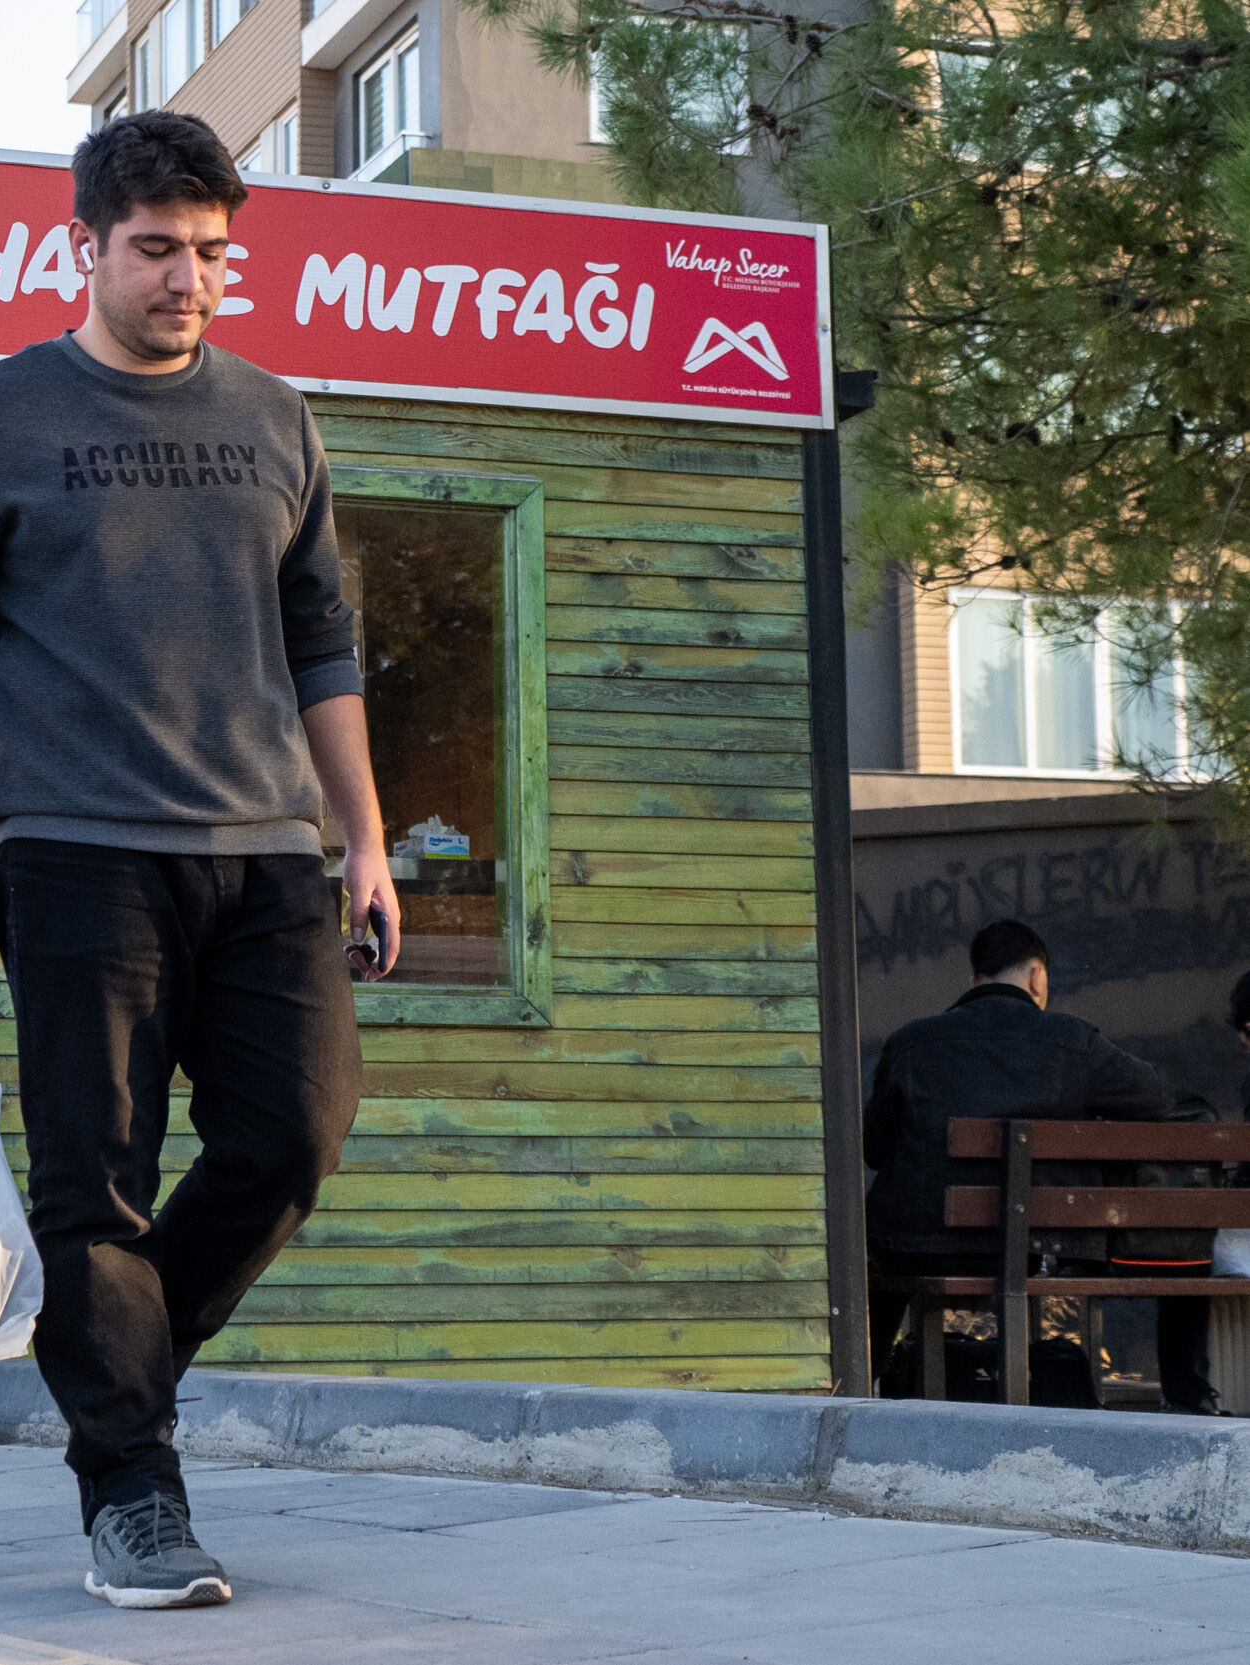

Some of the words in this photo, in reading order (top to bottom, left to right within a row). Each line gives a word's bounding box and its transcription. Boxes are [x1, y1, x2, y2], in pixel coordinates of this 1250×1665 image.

[665, 239, 732, 287] Vahap
[736, 247, 790, 279] Seçer
[295, 252, 655, 351] MUTFAĞI
[63, 442, 260, 491] ACCURACY
